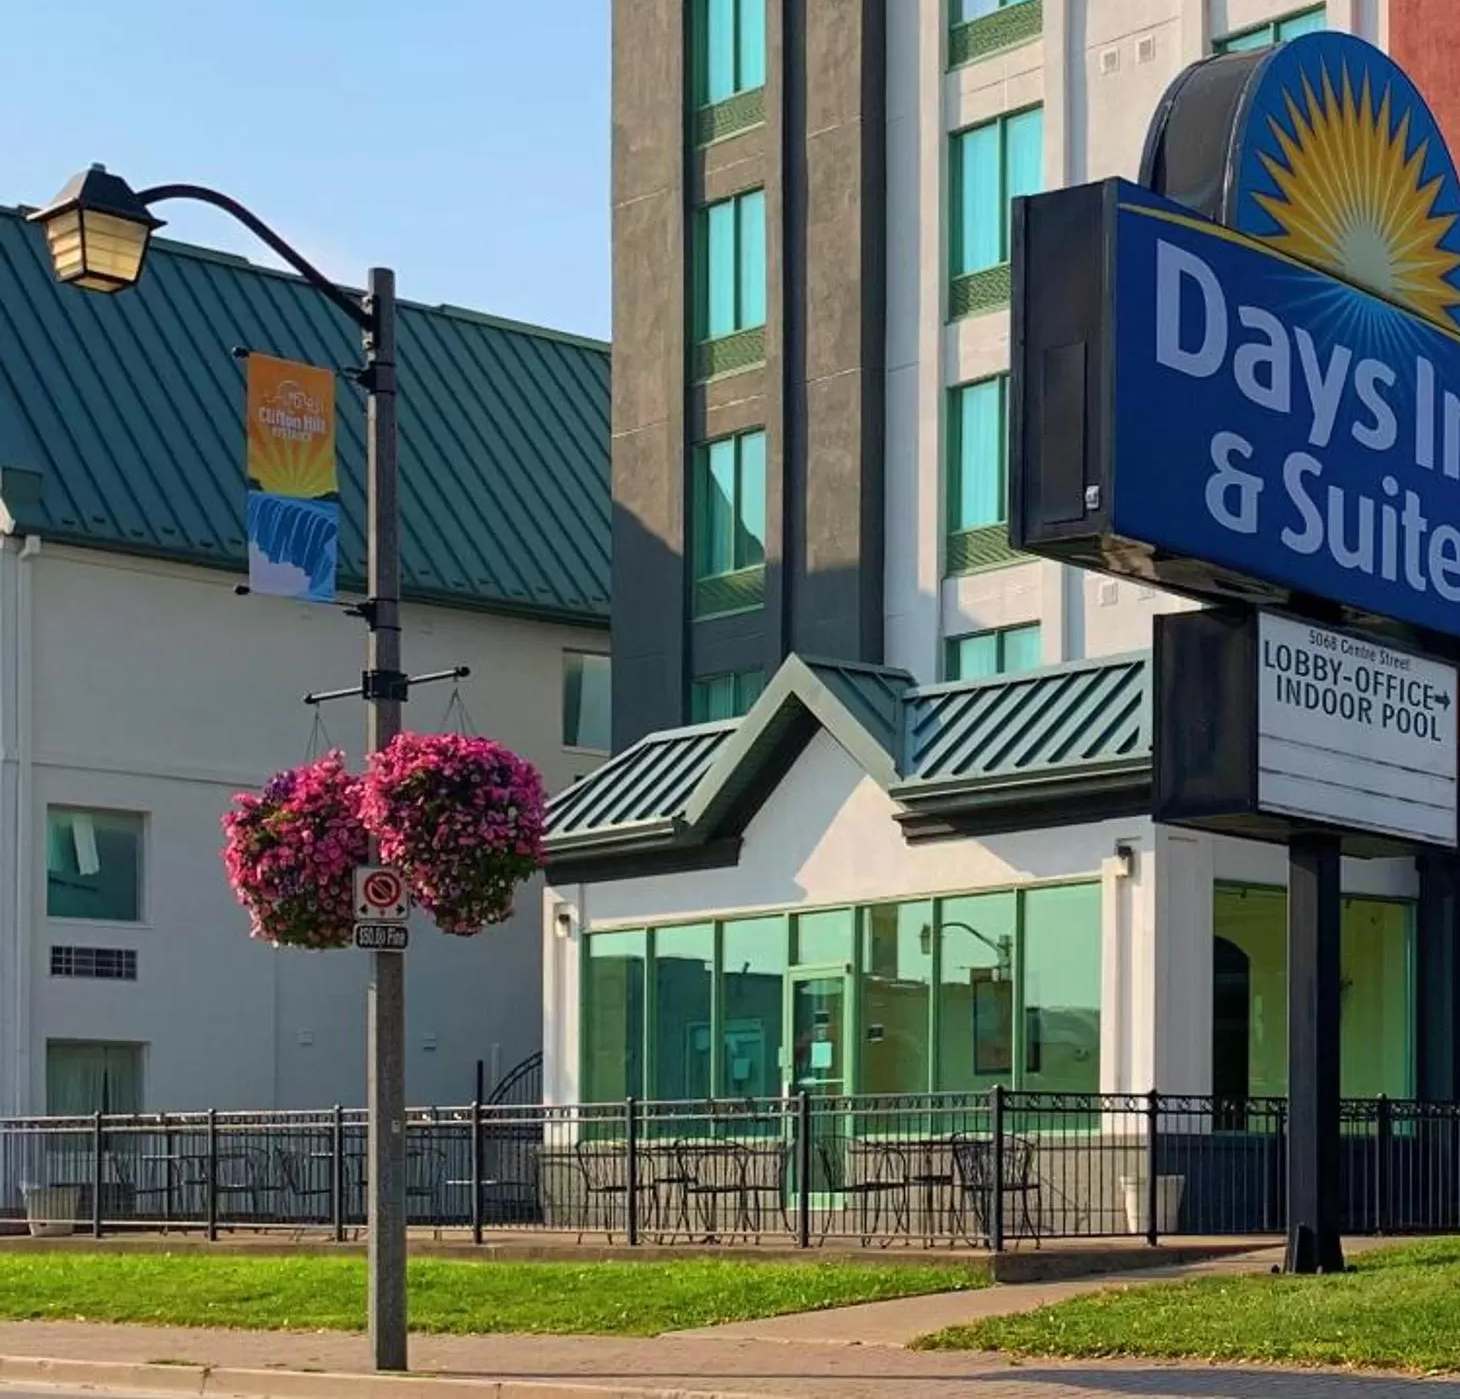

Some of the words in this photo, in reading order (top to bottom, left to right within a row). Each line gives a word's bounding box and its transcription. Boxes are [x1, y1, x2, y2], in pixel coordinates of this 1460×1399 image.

[1156, 237, 1398, 452] Days
[1205, 430, 1265, 534] &
[1264, 640, 1434, 711] LOBBY-OFFICE
[1341, 639, 1377, 663] Centre
[1380, 651, 1411, 672] Street
[1276, 674, 1373, 725] INDOOR
[1382, 702, 1442, 742] POOL
